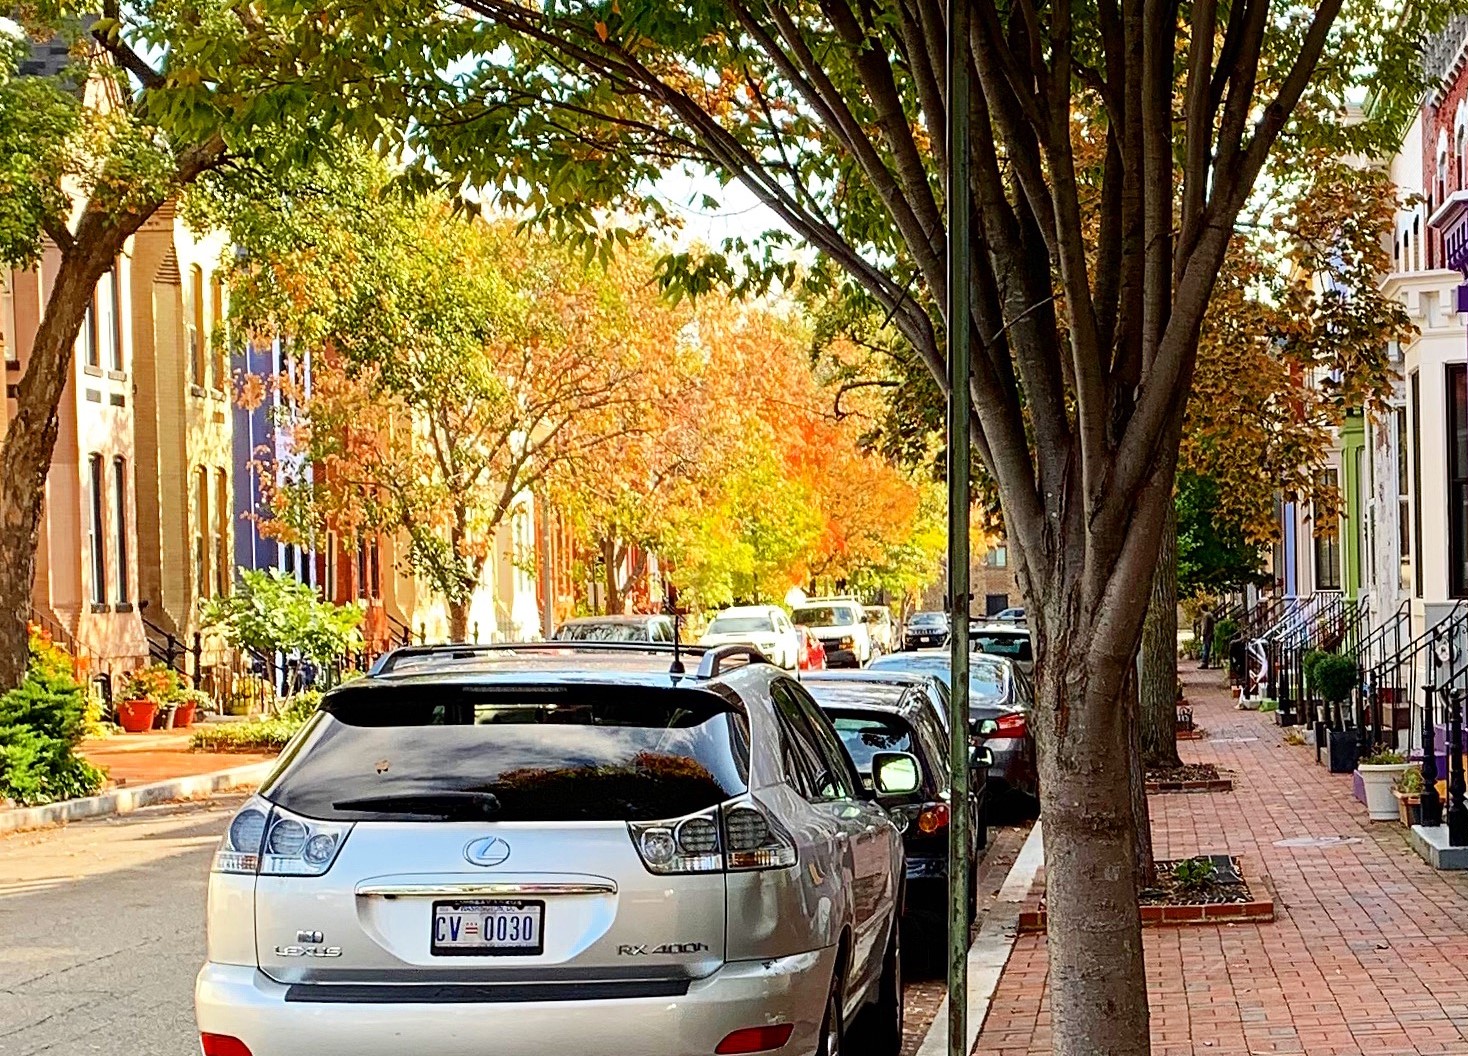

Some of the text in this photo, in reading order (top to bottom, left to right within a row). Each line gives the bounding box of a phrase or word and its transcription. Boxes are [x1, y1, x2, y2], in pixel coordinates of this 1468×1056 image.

[436, 916, 533, 941] CV 0030
[274, 945, 343, 957] LEXUS
[617, 942, 709, 956] RX 400h
